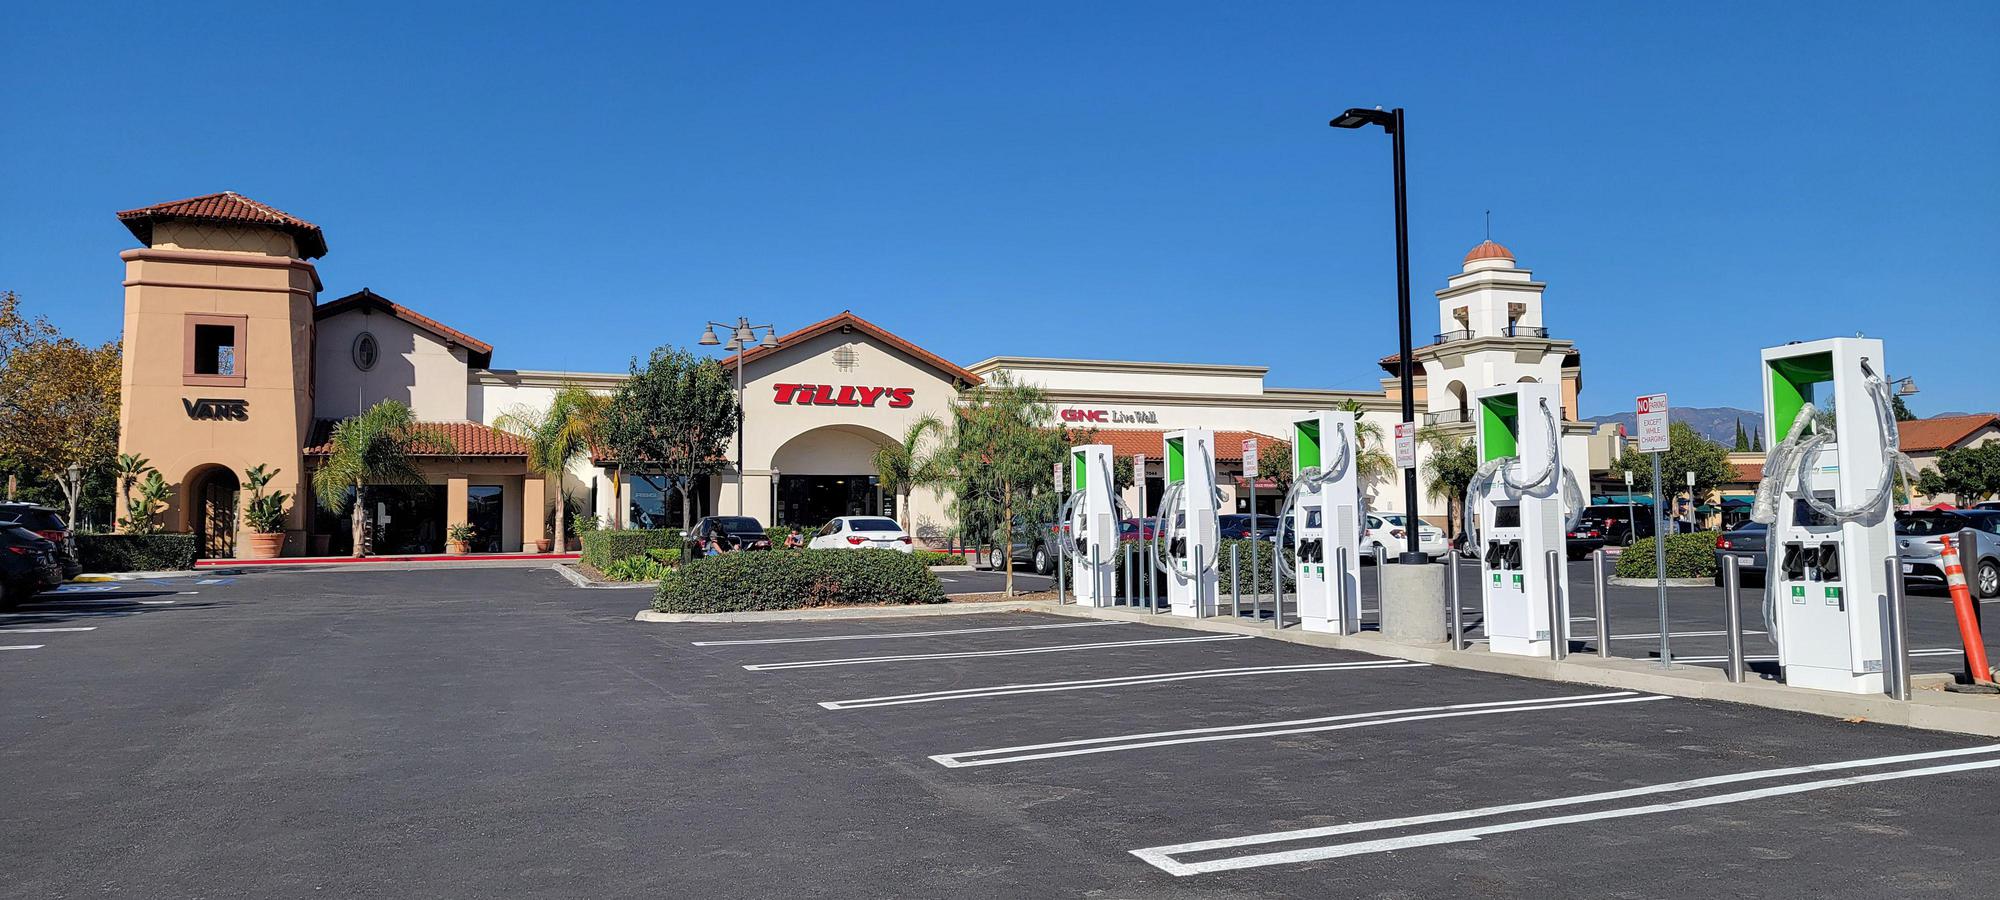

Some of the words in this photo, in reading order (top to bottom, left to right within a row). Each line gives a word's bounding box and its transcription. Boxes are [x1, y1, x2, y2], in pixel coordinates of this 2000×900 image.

[182, 398, 249, 421] VANS
[1638, 400, 1649, 413] NO
[1061, 409, 1109, 423] GNC
[1112, 410, 1135, 423] Live
[1644, 418, 1662, 426] EXCEPT
[1641, 435, 1666, 443] CHARGING
